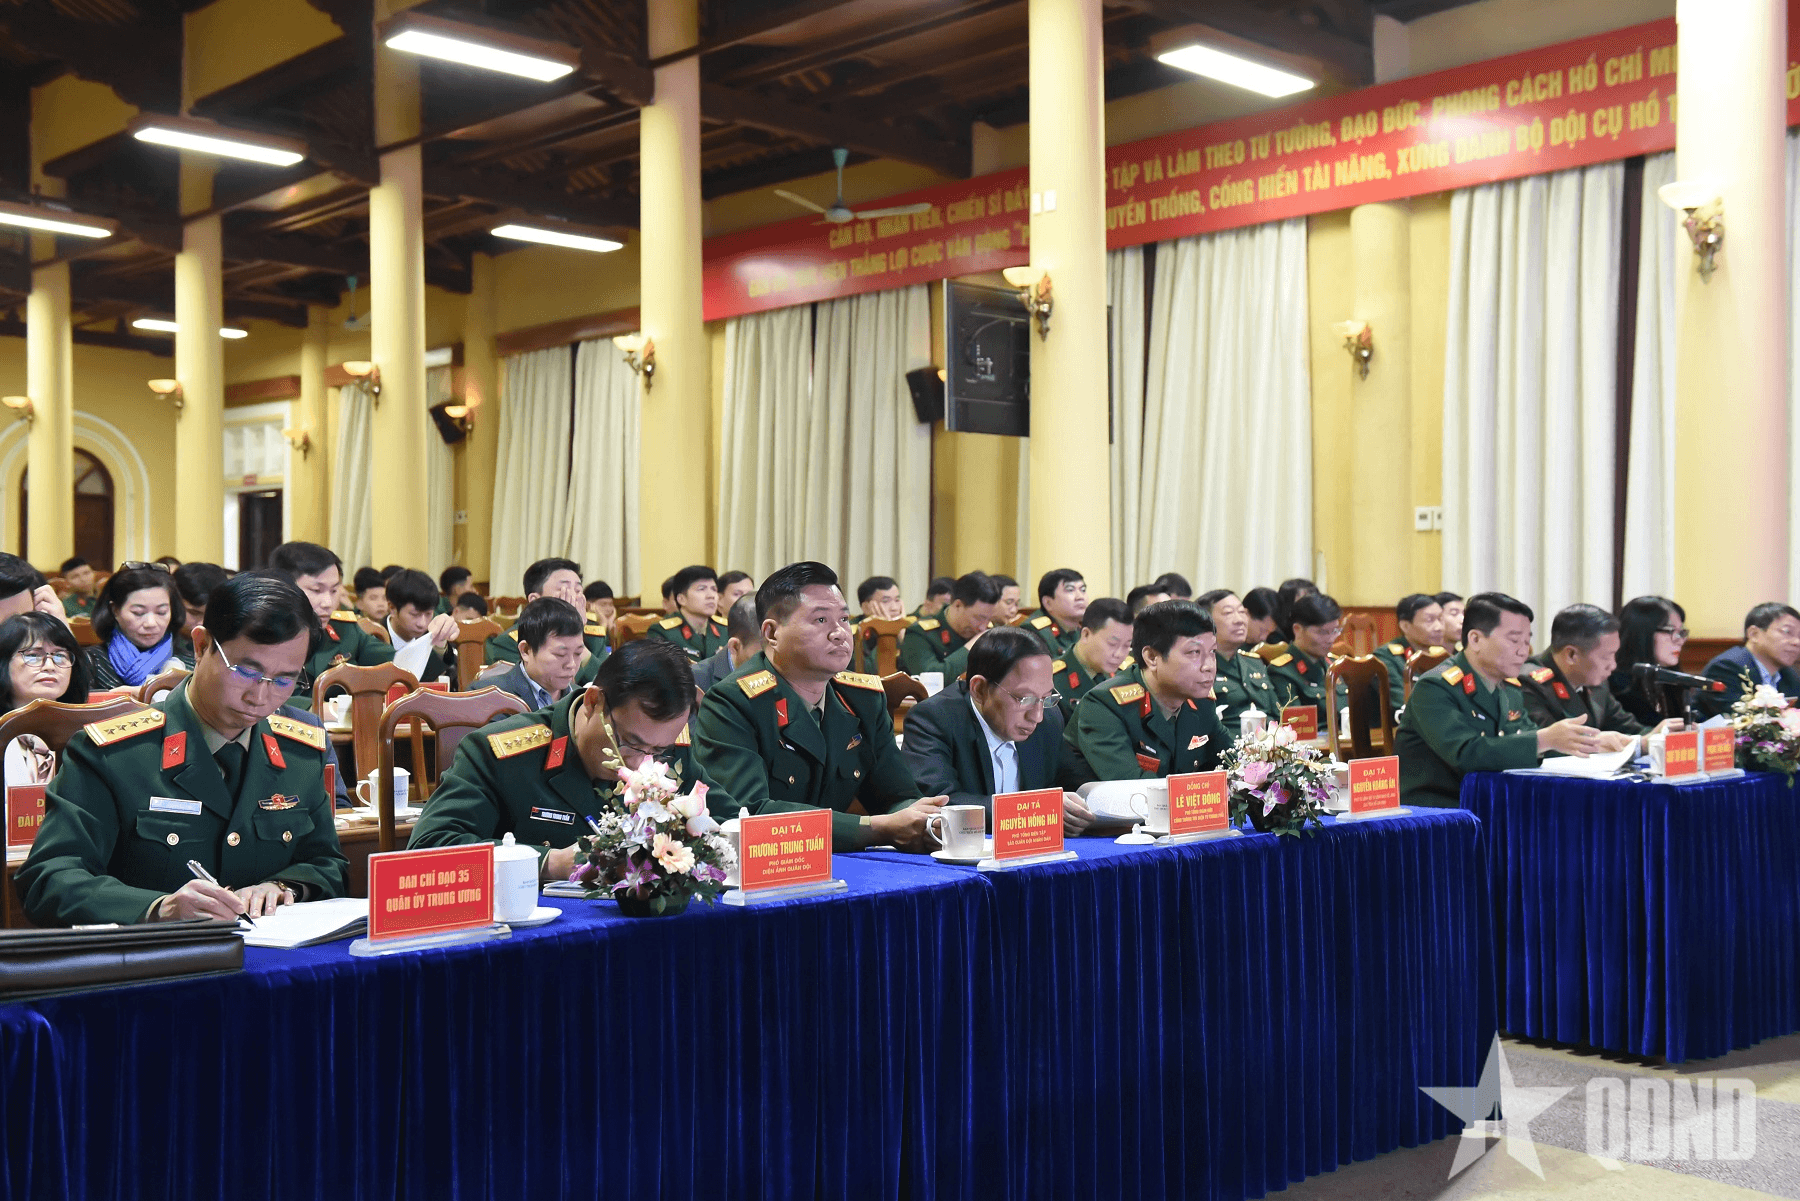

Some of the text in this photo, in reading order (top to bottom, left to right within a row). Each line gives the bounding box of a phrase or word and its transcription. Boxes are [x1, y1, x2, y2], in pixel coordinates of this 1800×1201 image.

[1112, 160, 1140, 193] TẬP
[1143, 154, 1164, 184] VÀ
[1166, 148, 1201, 179] LÀM
[1205, 139, 1246, 170] THEO
[1340, 110, 1378, 145] ĐẠO
[1506, 71, 1563, 107] CÁCH
[1604, 46, 1643, 87] CHÍ
[1303, 160, 1331, 192] TÀI
[1515, 116, 1545, 156] BỘ
[1550, 108, 1587, 150] ĐỘI
[1593, 105, 1624, 141] CỤ
[1362, 766, 1386, 777] ĐẠI TÁ
[1202, 780, 1210, 789] CHÍ
[1016, 799, 1041, 812] ĐẠI TÁ
[1175, 794, 1185, 808] LÊ
[1185, 792, 1201, 808] VIỆT
[1000, 813, 1027, 831] NGUYỄN
[1047, 809, 1058, 825] HẢI
[771, 821, 803, 837] ĐẠI TÁ
[748, 833, 824, 858] TRƯƠNG TRUNG TUẤN
[780, 857, 794, 865] GIÁM
[787, 864, 802, 872] QUÂN
[802, 862, 812, 871] ĐỘI
[398, 869, 470, 890] BAN CHỈ ĐẠO 35
[386, 888, 482, 913] QUÂN ỦY TRUNG ƯƠNG
